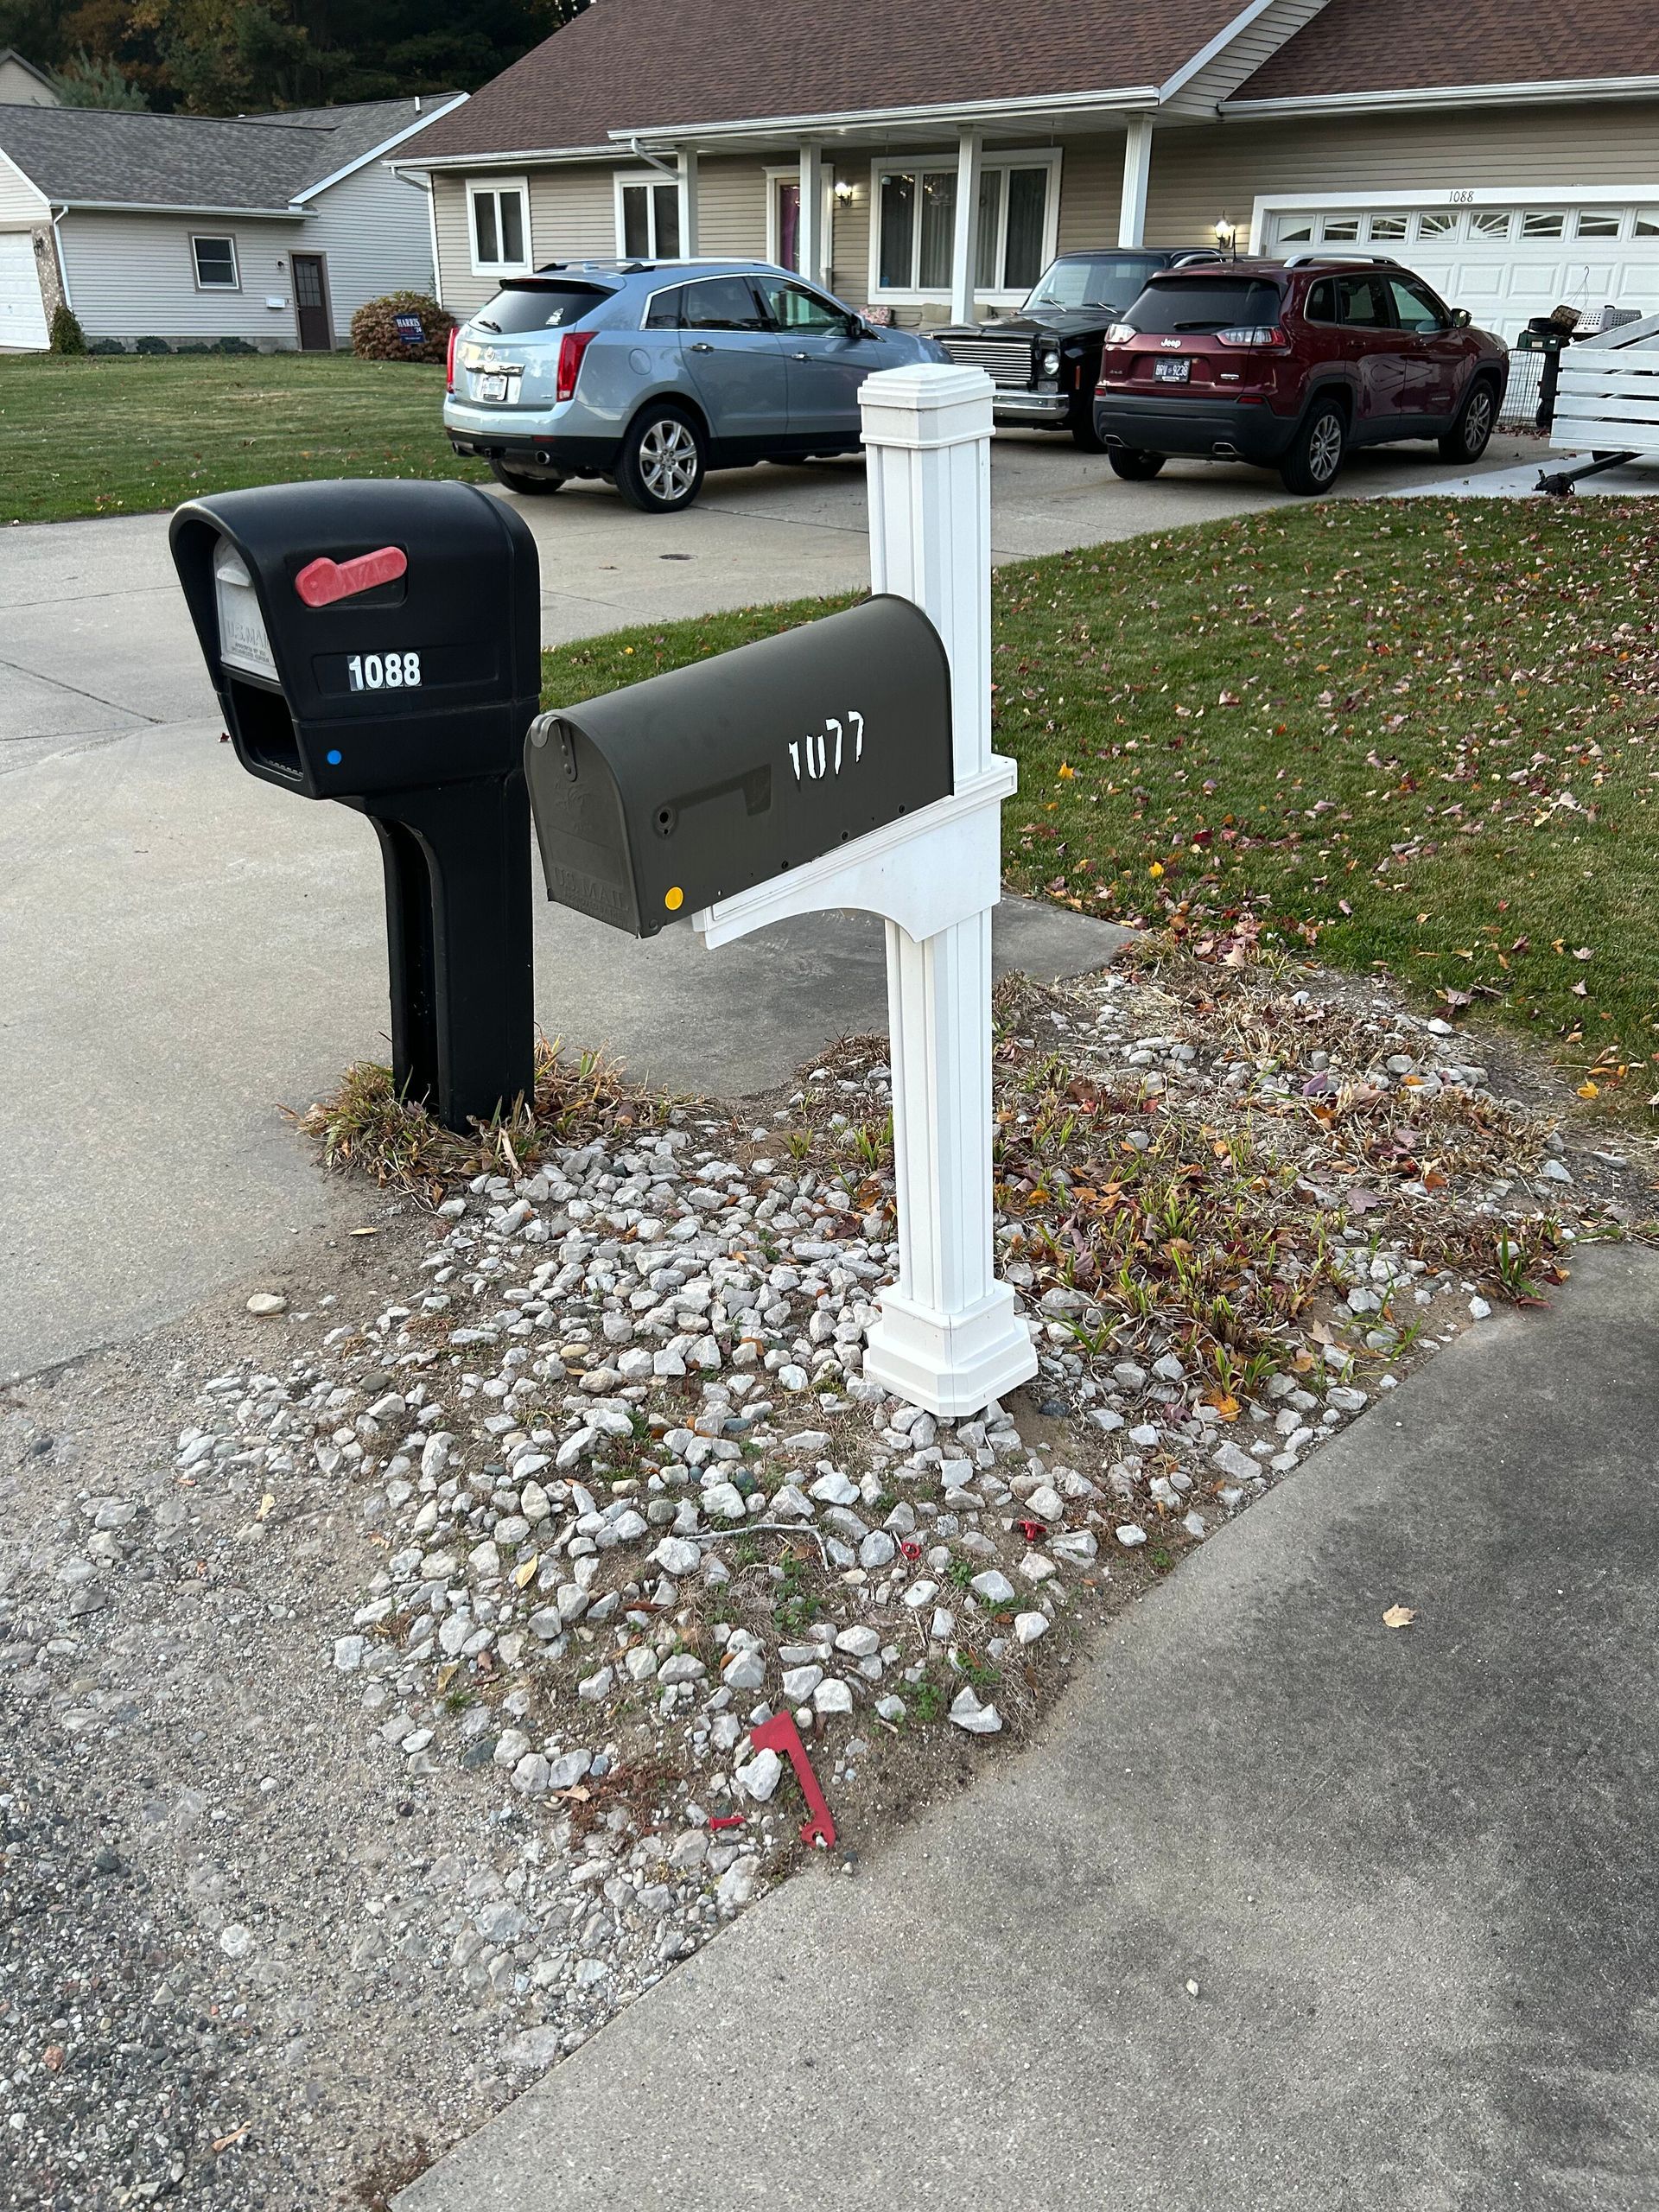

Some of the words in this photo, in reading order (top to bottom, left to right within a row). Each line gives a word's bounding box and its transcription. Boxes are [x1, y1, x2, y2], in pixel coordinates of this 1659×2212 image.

[1449, 190, 1474, 203] 1088
[396, 318, 420, 327] HARRIS
[1160, 338, 1181, 349] Jeep
[348, 652, 421, 690] 1088
